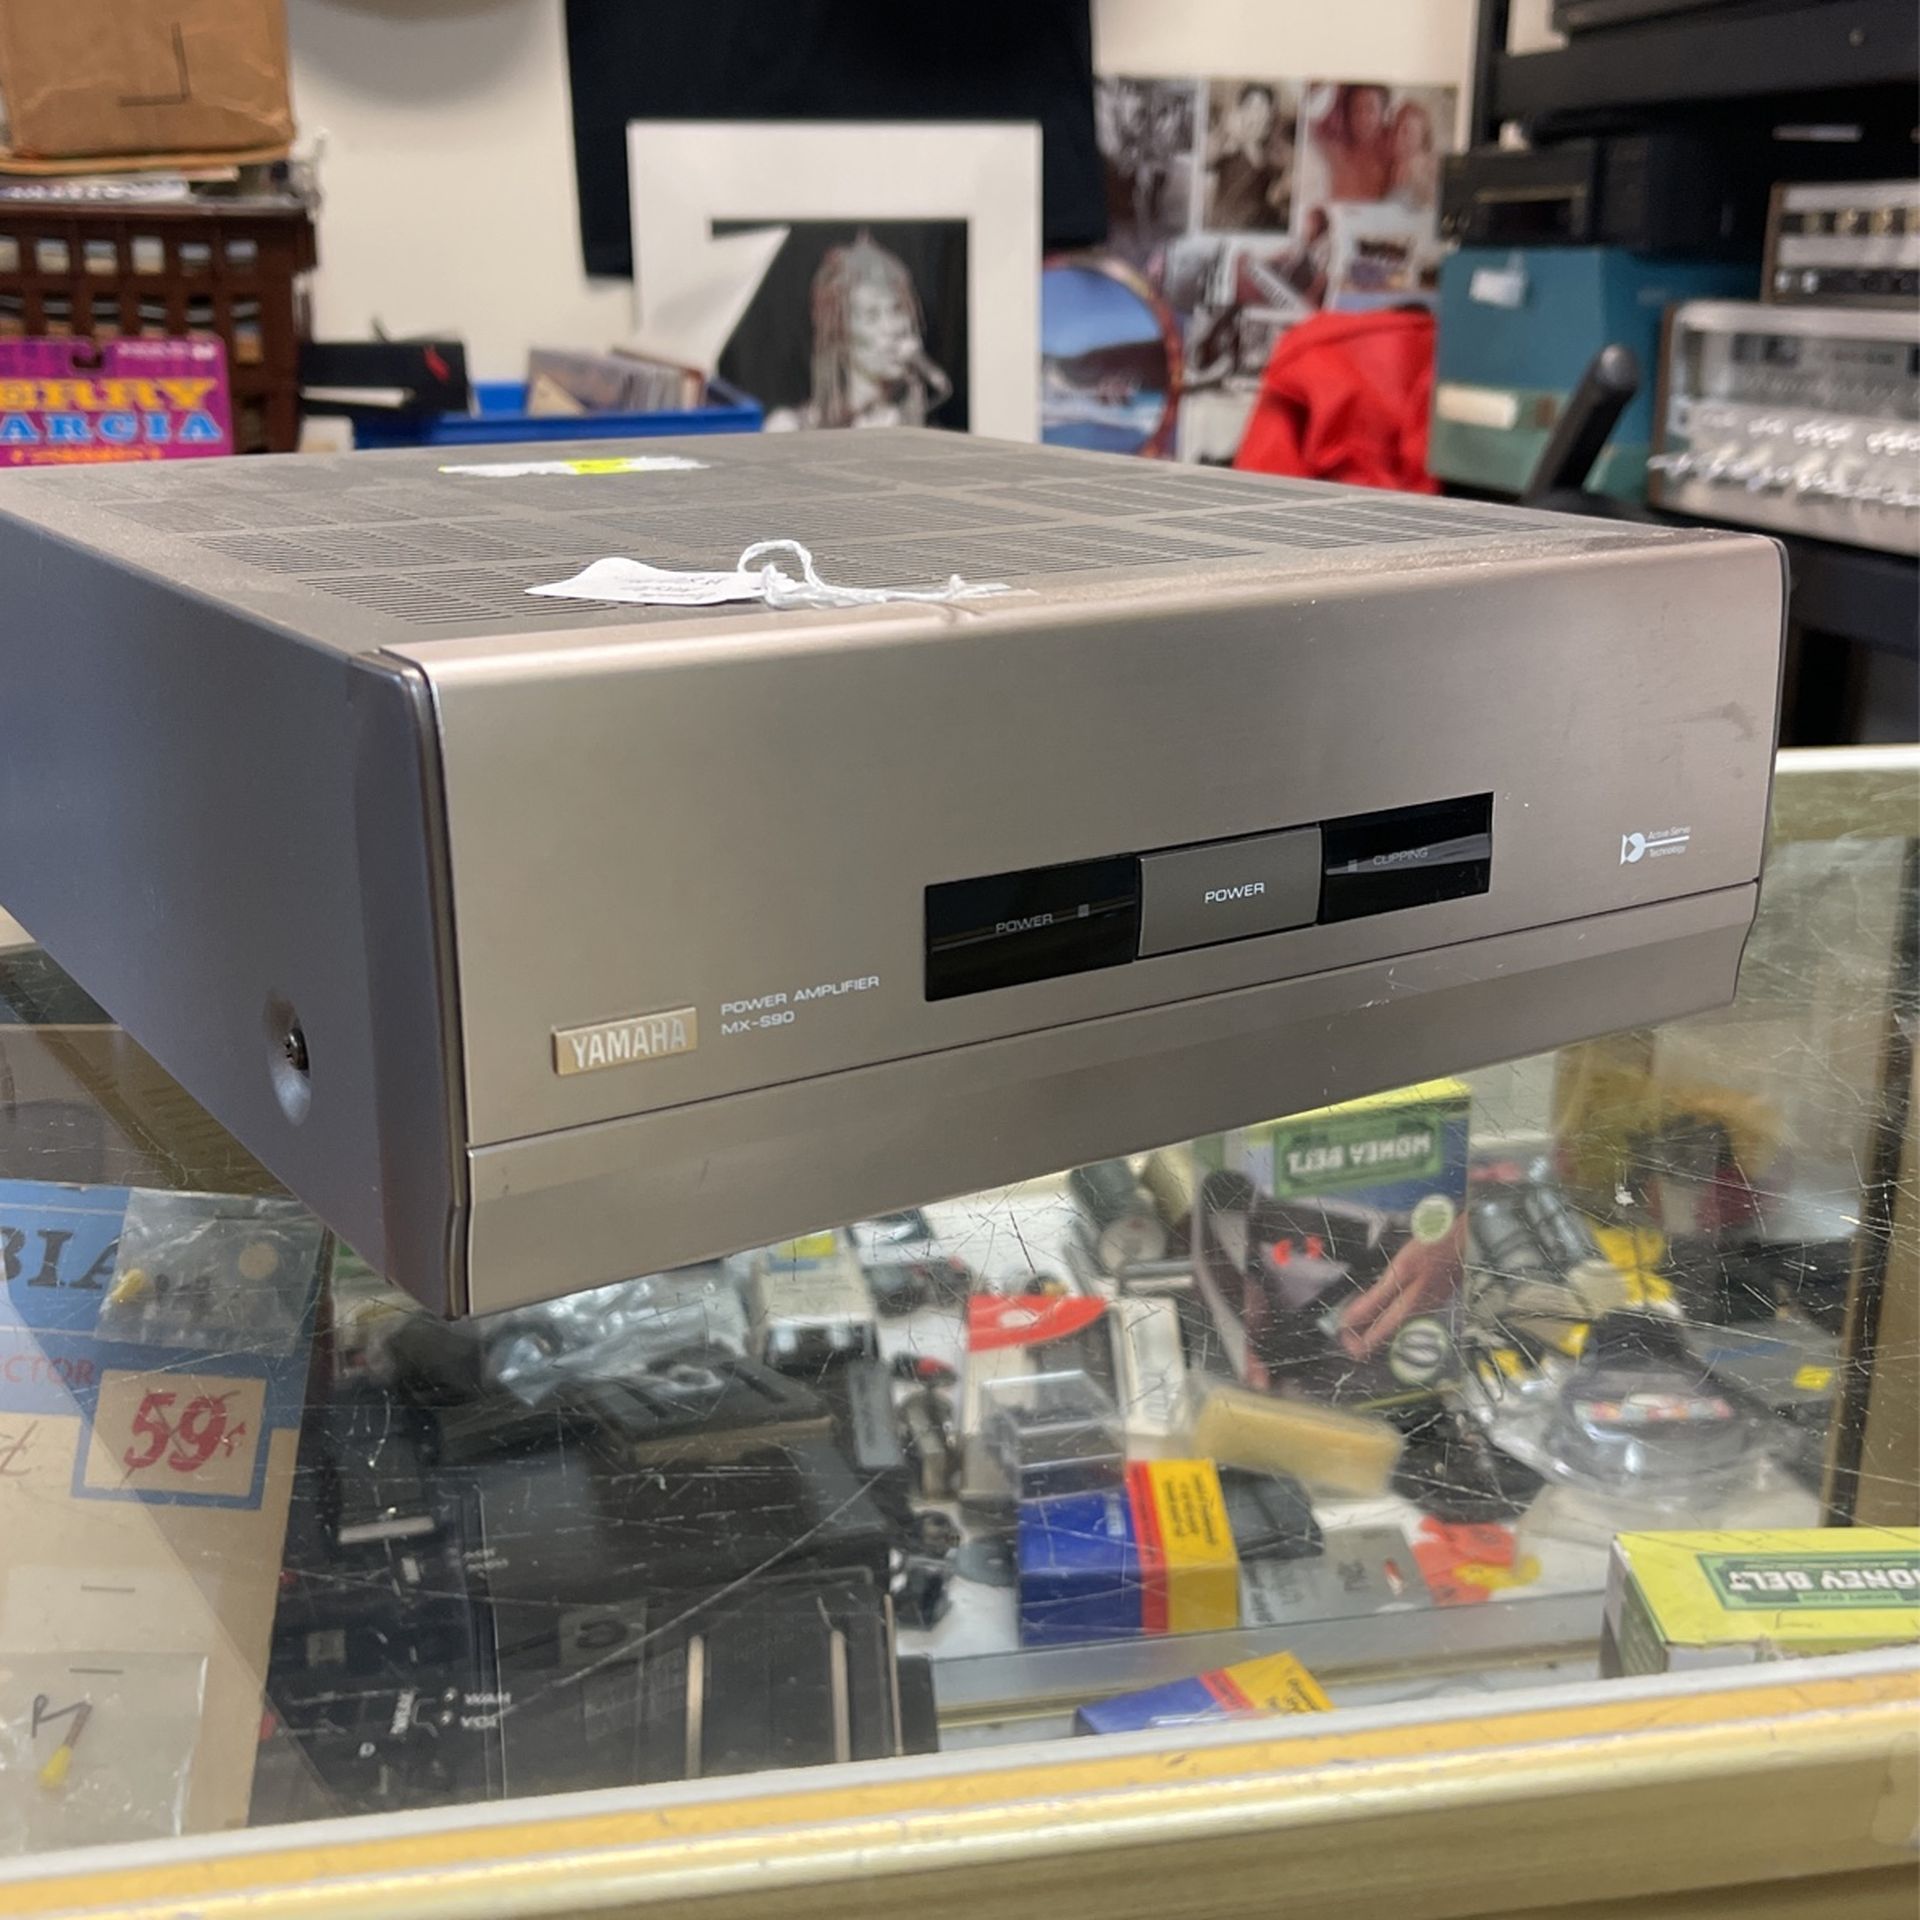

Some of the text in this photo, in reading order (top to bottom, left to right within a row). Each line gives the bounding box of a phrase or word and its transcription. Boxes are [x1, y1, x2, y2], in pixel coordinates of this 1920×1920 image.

[1373, 846, 1429, 866] CLIPPING
[1204, 882, 1265, 904] POWER
[995, 912, 1054, 935] POWER
[720, 975, 880, 1016] POWER AMPLIFIER
[720, 1011, 796, 1036] MX-S90
[571, 1017, 687, 1071] YAMAHA
[1729, 1568, 1920, 1591] ONEY BELT
